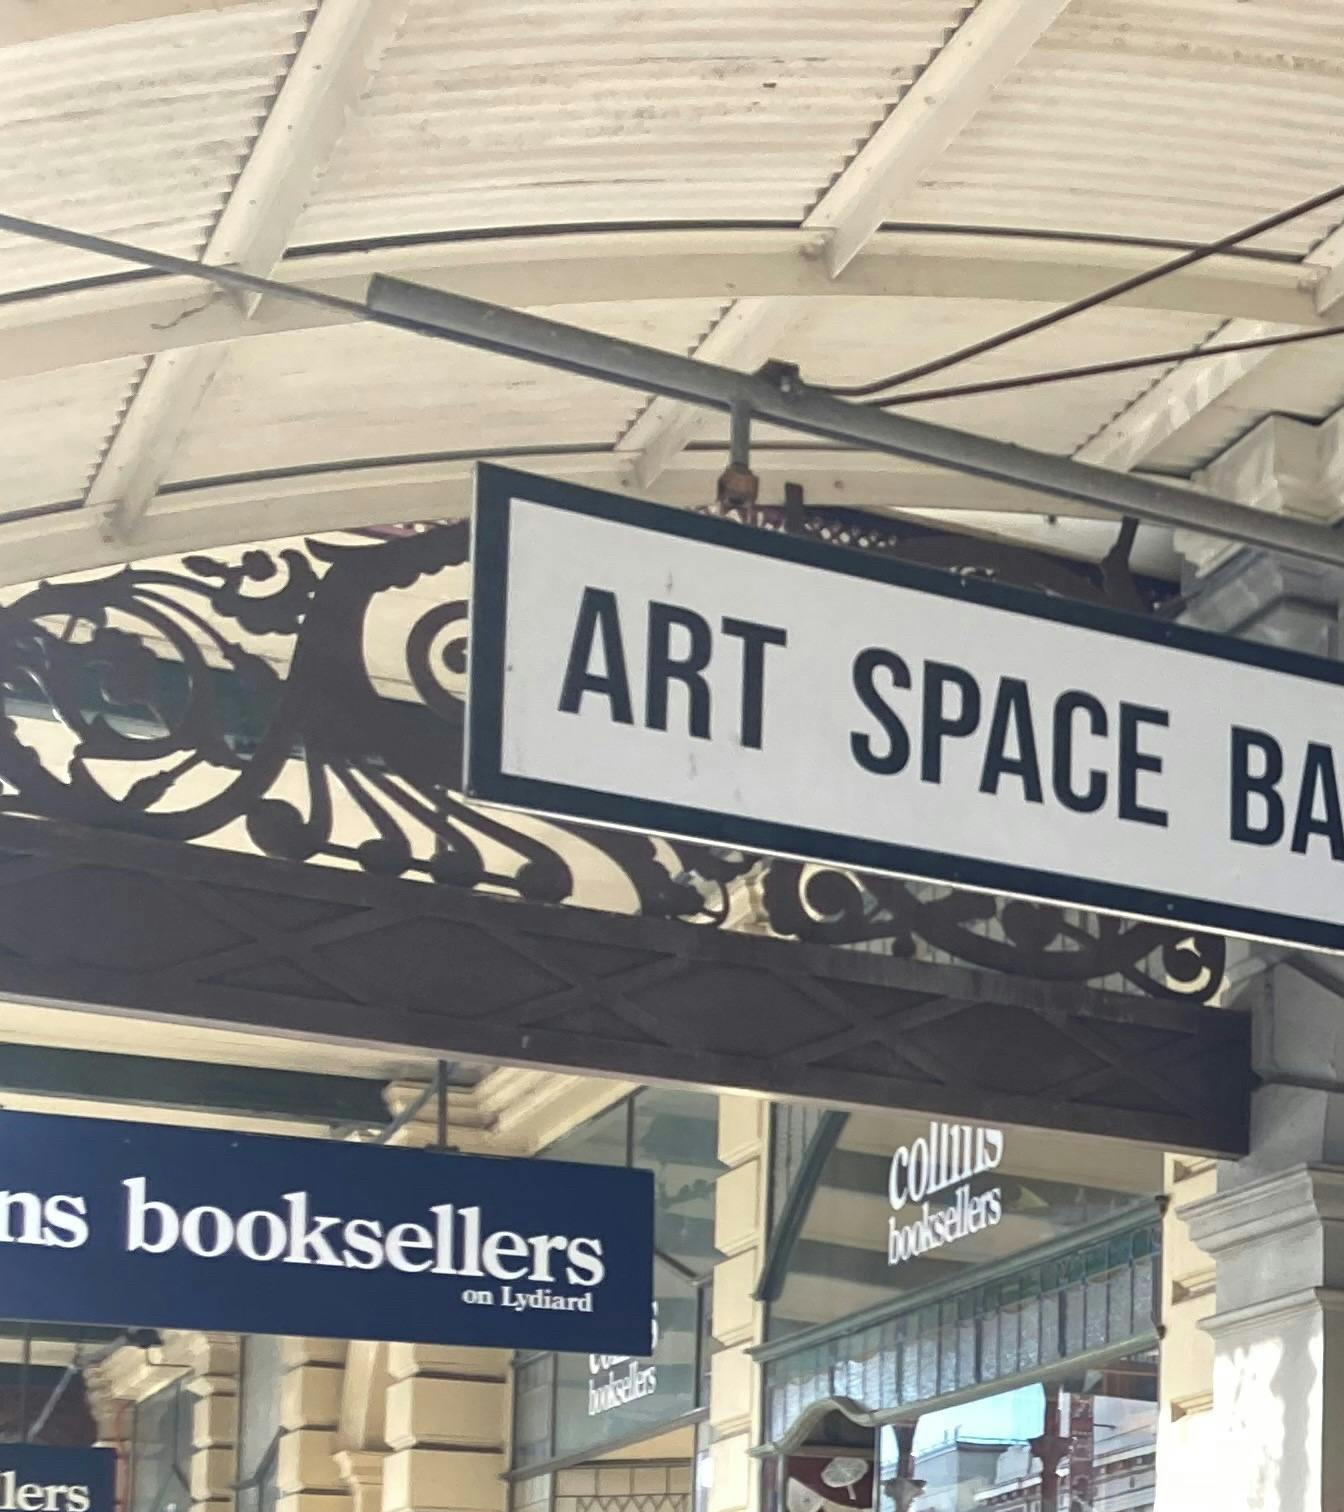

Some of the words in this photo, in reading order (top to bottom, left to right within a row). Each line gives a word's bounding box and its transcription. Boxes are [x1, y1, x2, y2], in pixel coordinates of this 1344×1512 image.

[557, 586, 788, 750] ART
[849, 646, 1170, 827] SPACE
[123, 1177, 606, 1287] booksellers
[888, 1184, 1002, 1265] booksellers
[462, 1289, 494, 1306] on
[501, 1286, 593, 1313] Lydiard
